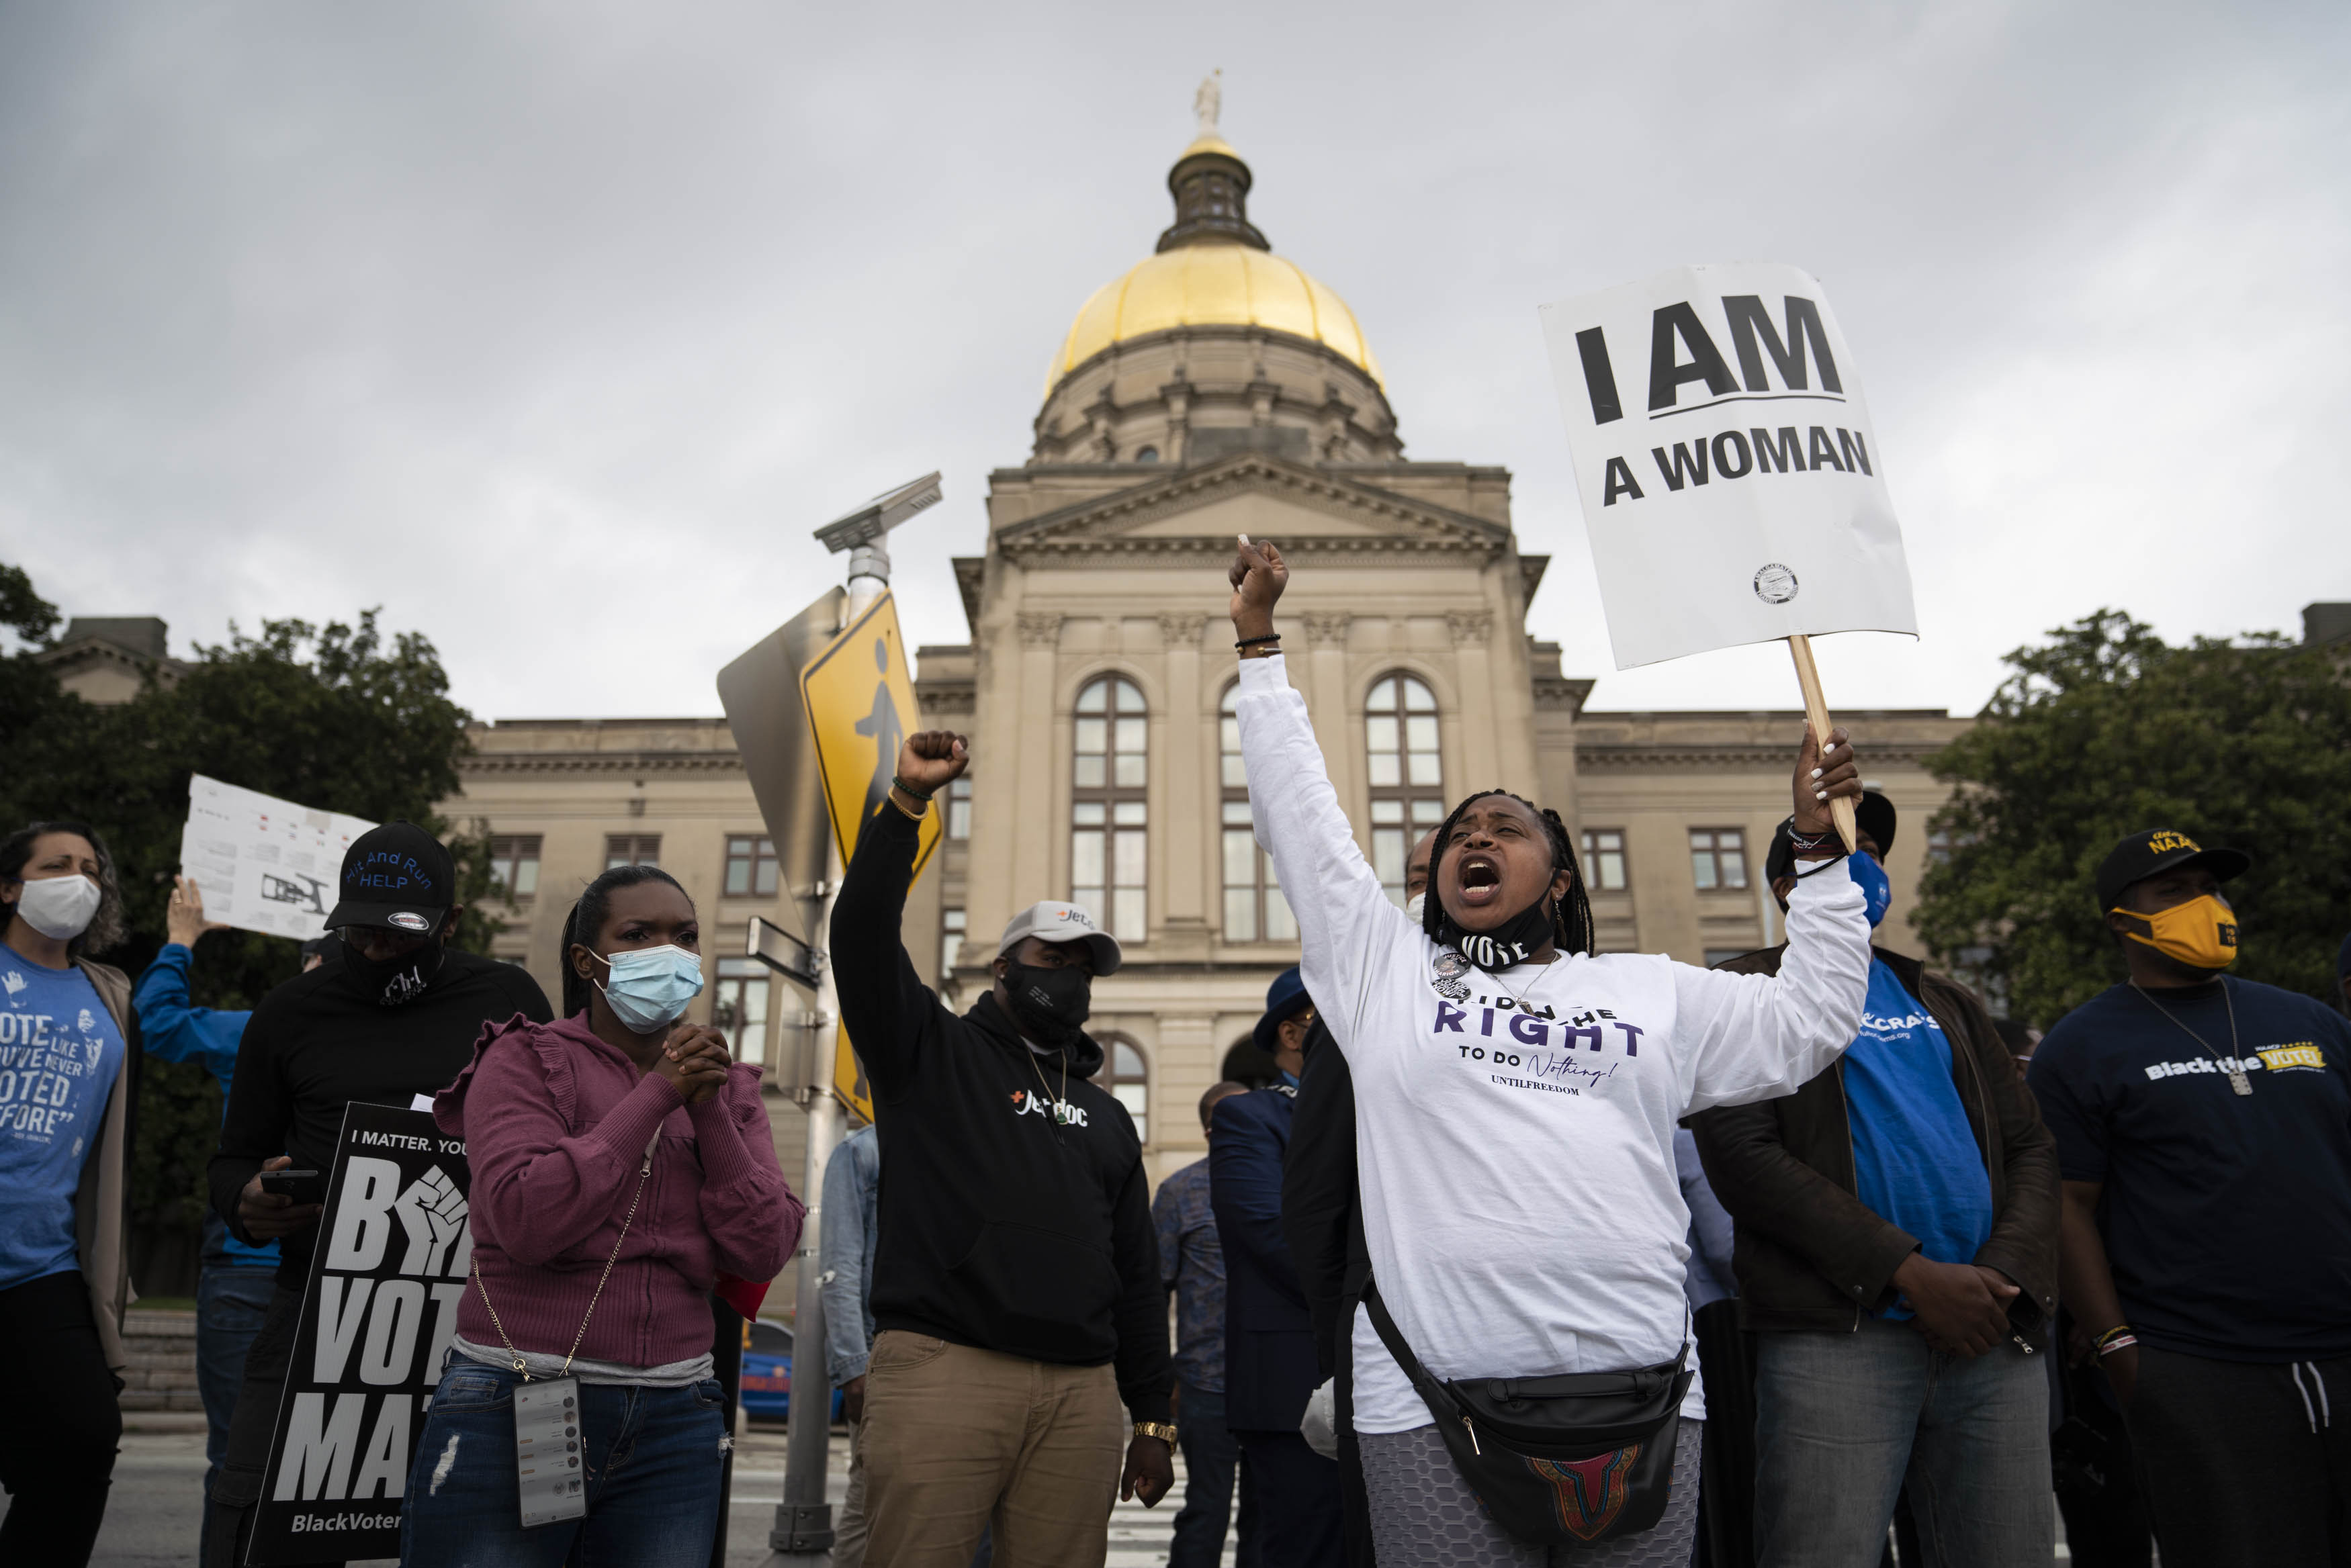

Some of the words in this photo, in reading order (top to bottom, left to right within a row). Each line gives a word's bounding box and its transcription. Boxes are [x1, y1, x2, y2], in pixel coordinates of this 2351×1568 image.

[1575, 326, 1624, 426] I
[1648, 295, 1844, 412] AM
[1603, 455, 1645, 508] A
[1651, 426, 1873, 492] WOMAN
[359, 874, 408, 890] HELP
[367, 851, 402, 866] And
[403, 858, 432, 890] Run
[1443, 953, 1467, 963] JUSTICE
[1461, 934, 1529, 968] VOTE
[1433, 984, 1455, 998] NOW!
[1441, 979, 1466, 993] VOTER
[1447, 978, 1468, 990] STOP
[1433, 1001, 1644, 1058] RIGHT
[0, 1046, 46, 1069] U'VE
[45, 1054, 83, 1077] NEVER
[50, 1036, 79, 1059] LIKE
[1459, 1045, 1485, 1060] TO
[1493, 1051, 1521, 1067] DO
[1527, 1052, 1618, 1088] Nothing!
[2144, 1056, 2217, 1080] Black
[2215, 1056, 2262, 1074] the
[2264, 1049, 2320, 1066] VOTE!
[1491, 1074, 1580, 1097] UNTILFREEDOM
[0, 1104, 75, 1136] FORE”
[351, 1129, 358, 1143] I
[361, 1131, 432, 1152] MATTER.
[273, 1392, 434, 1502] MA
[291, 1512, 402, 1532] BlackVoter
